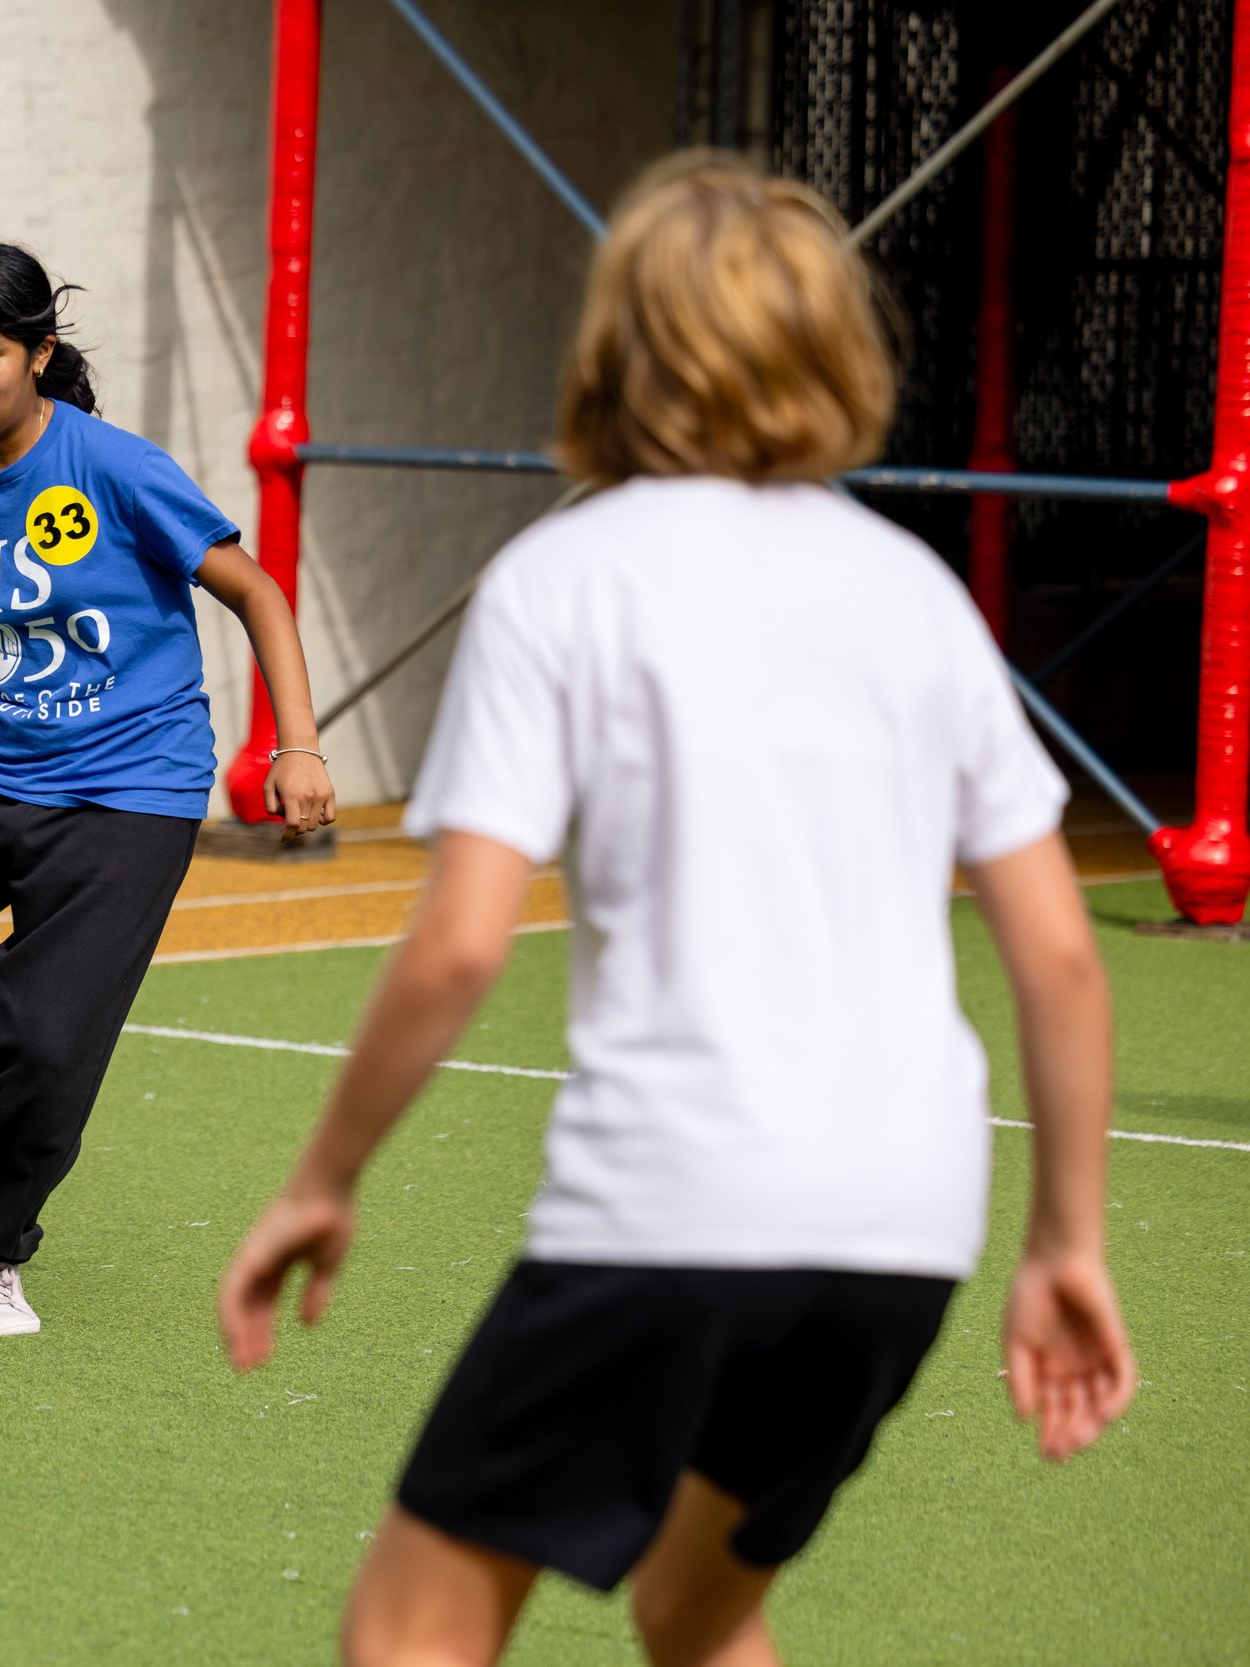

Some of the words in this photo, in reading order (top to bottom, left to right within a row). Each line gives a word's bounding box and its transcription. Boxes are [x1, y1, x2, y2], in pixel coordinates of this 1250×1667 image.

[33, 502, 91, 549] 33
[23, 608, 111, 683] 50
[69, 675, 116, 698] THE
